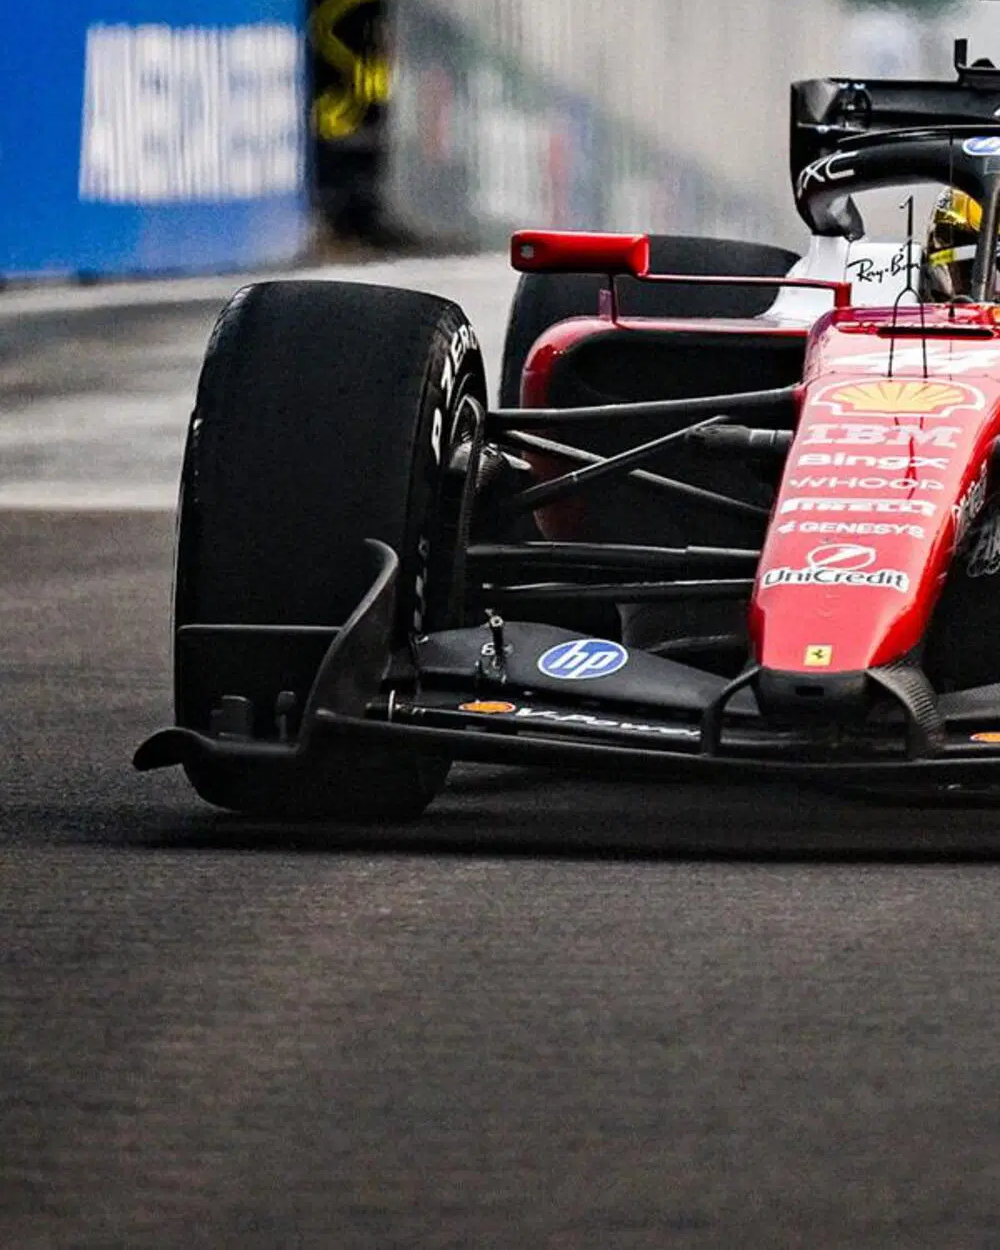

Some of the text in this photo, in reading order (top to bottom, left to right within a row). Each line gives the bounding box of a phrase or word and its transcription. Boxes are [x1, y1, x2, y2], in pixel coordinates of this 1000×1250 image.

[799, 150, 859, 193] XC
[802, 423, 962, 449] IBM
[797, 452, 949, 470] BingX
[789, 476, 945, 490] WHOOP
[799, 521, 926, 539] GENESYS
[763, 567, 906, 590] UniCredit
[548, 638, 616, 679] hp
